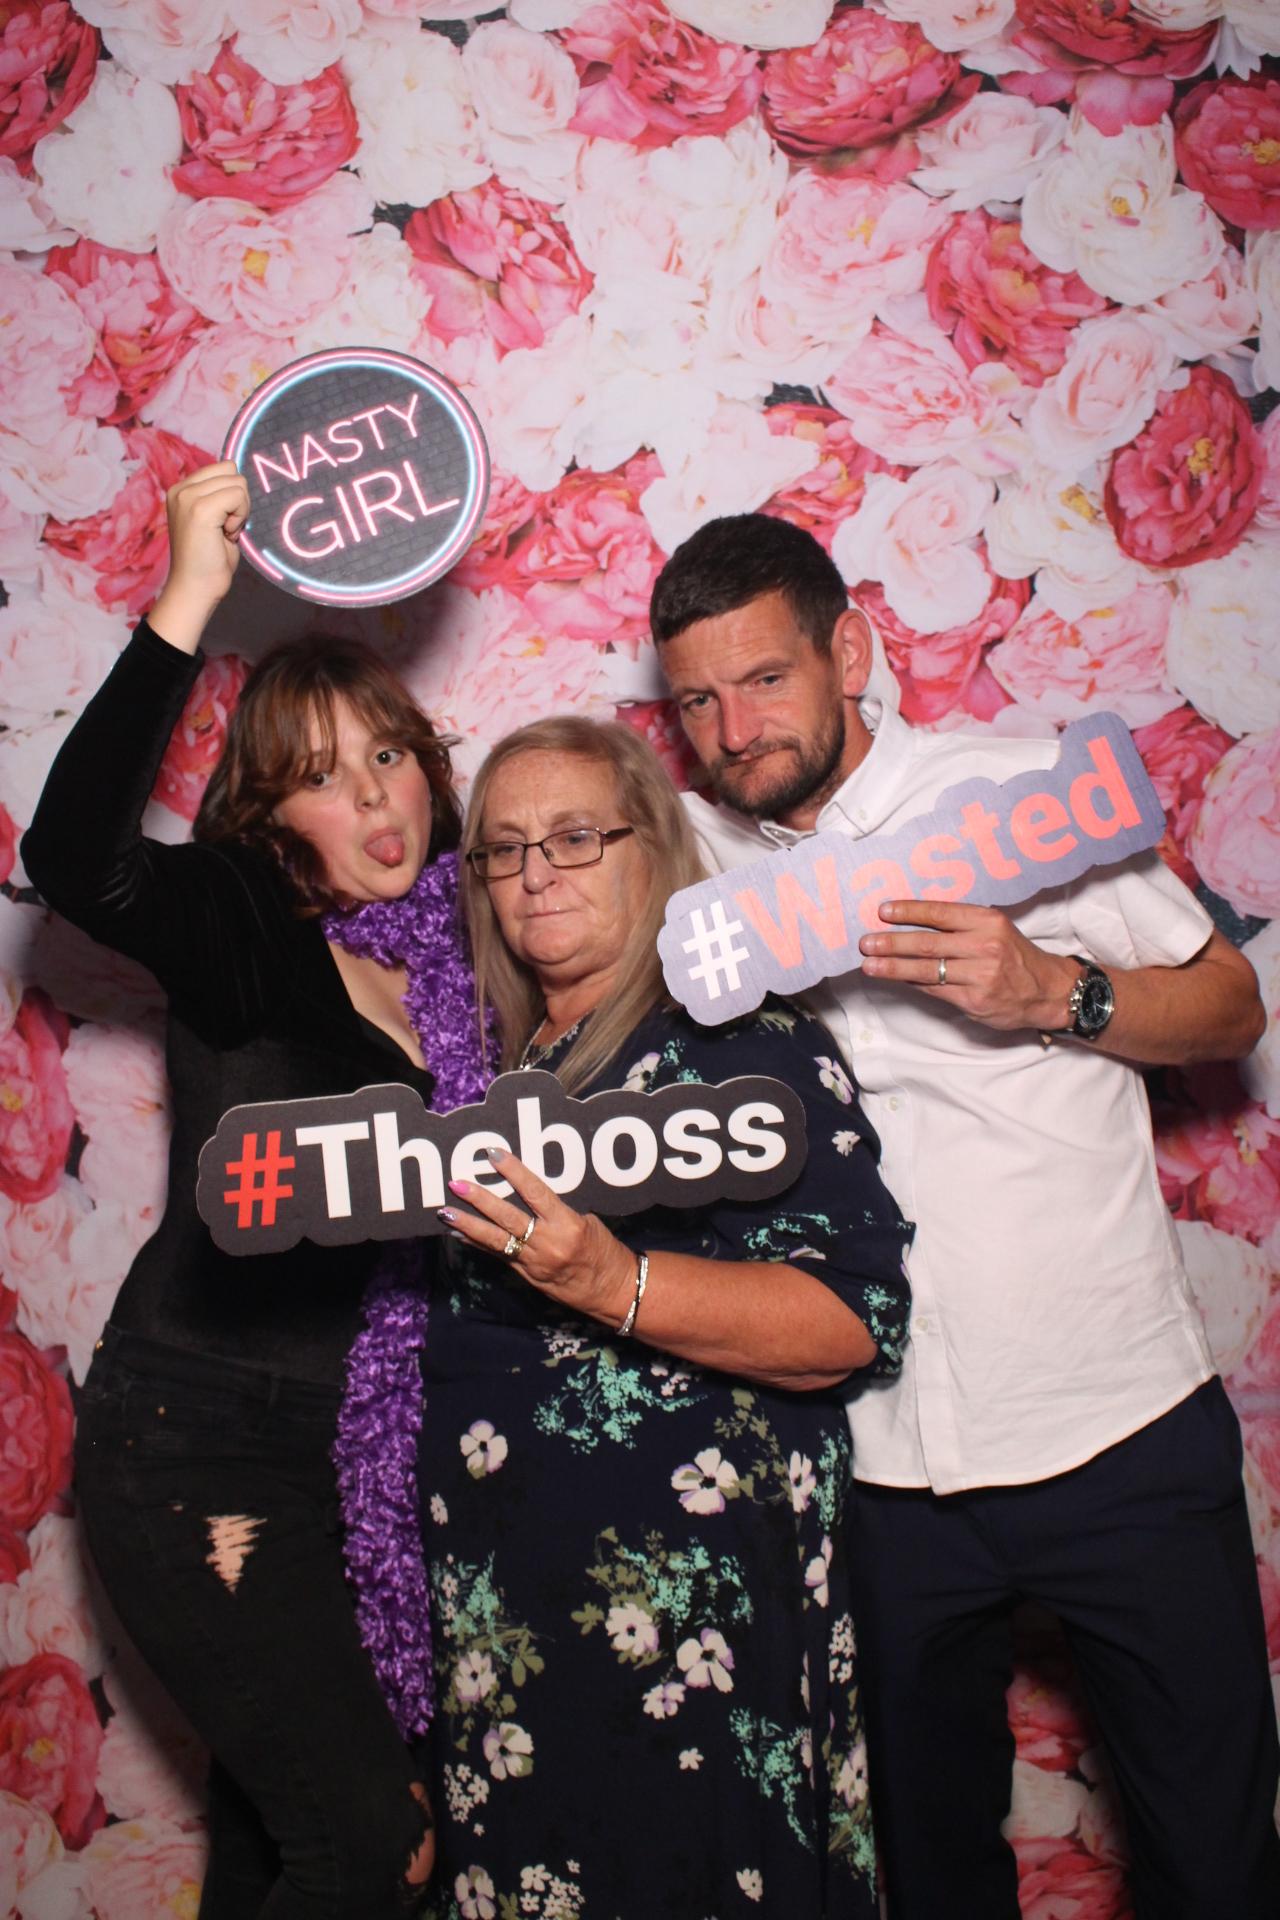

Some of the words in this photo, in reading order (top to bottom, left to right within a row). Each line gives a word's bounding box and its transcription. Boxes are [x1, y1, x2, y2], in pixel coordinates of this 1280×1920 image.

[252, 393, 418, 493] NASTY
[282, 461, 460, 558] GIRL
[681, 735, 1142, 1000] #Wasted
[223, 1096, 787, 1228] #Theboss
